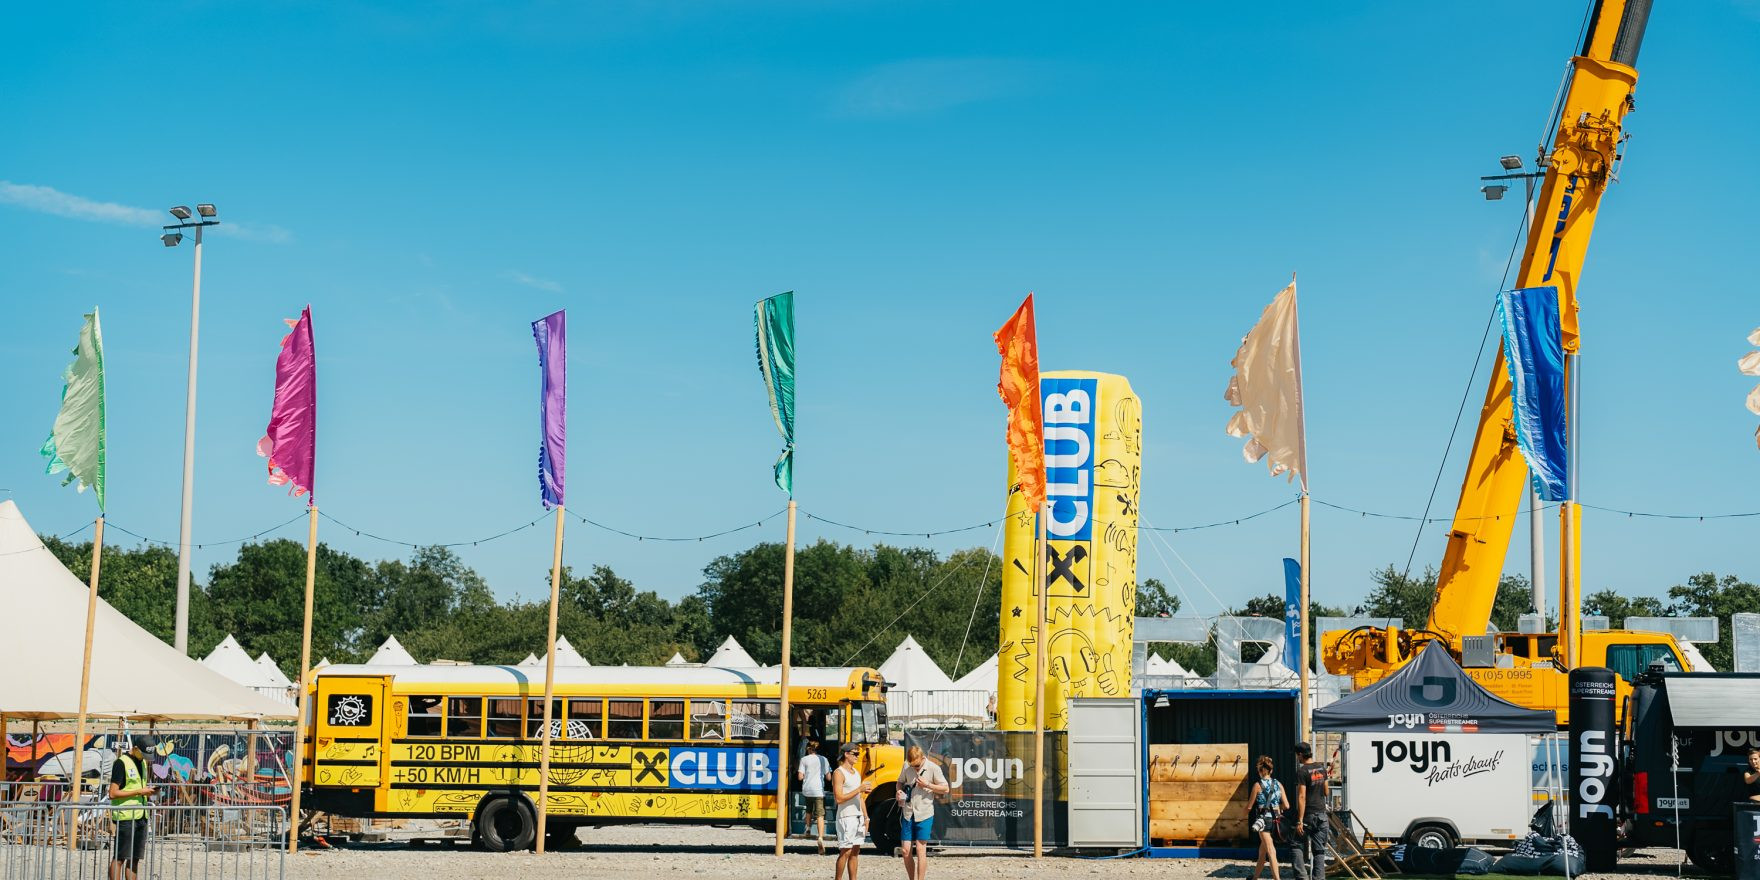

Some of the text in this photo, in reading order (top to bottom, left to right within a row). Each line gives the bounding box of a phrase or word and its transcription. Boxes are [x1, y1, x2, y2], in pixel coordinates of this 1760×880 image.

[1043, 388, 1091, 537] CLUB
[1483, 671, 1503, 681] (0)5
[1507, 671, 1532, 680] 0995
[807, 688, 827, 700] 5263
[406, 745, 480, 760] 120 BPM
[671, 751, 772, 785] CLUB
[1424, 750, 1504, 787] hat's drauf!
[394, 768, 480, 784] +50 KM/H
[957, 800, 1017, 809] ÖSTERREICHS
[951, 809, 1024, 817] SUPERSTREAMER
